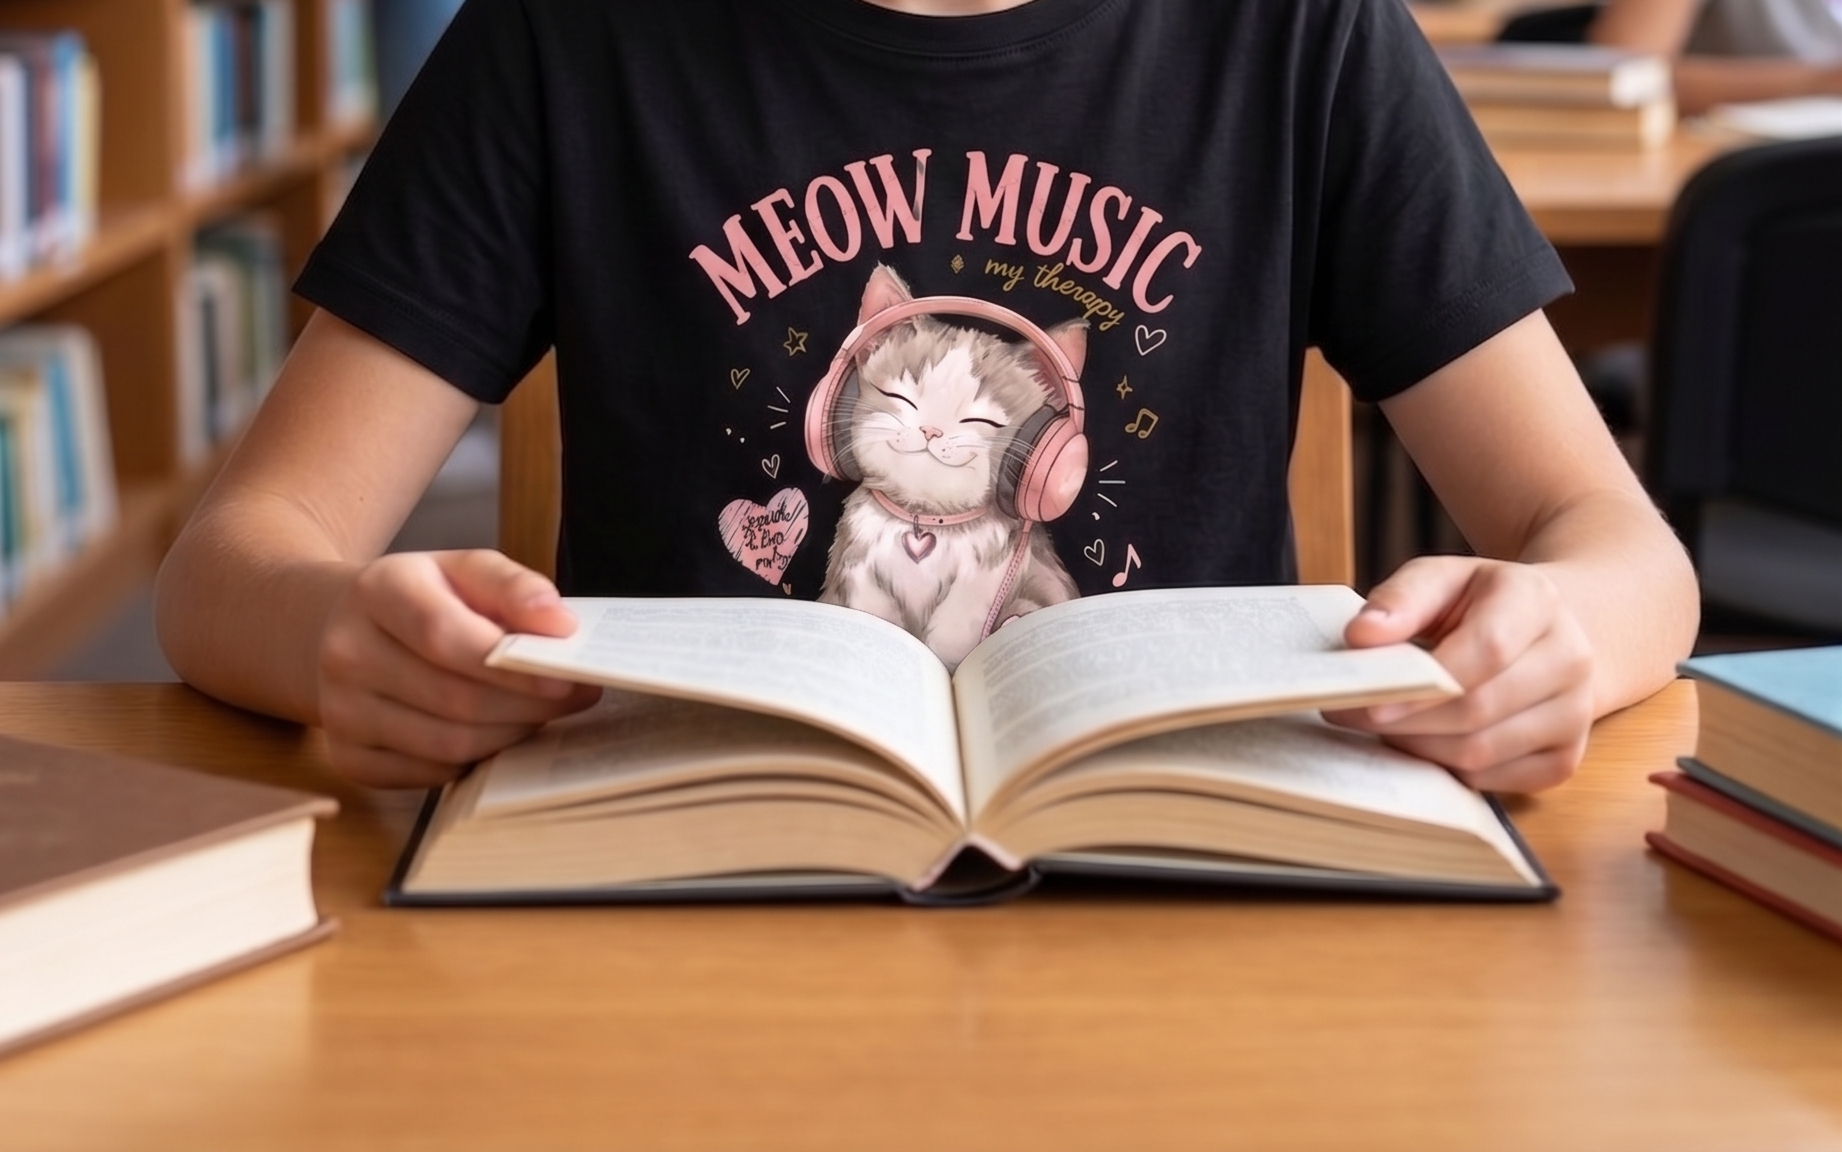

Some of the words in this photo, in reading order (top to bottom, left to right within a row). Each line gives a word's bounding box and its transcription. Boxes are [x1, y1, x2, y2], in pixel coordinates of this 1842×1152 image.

[688, 149, 932, 325] MEOW
[956, 151, 1202, 314] MUSIC
[984, 259, 1025, 292] my
[1033, 262, 1125, 331] therapy
